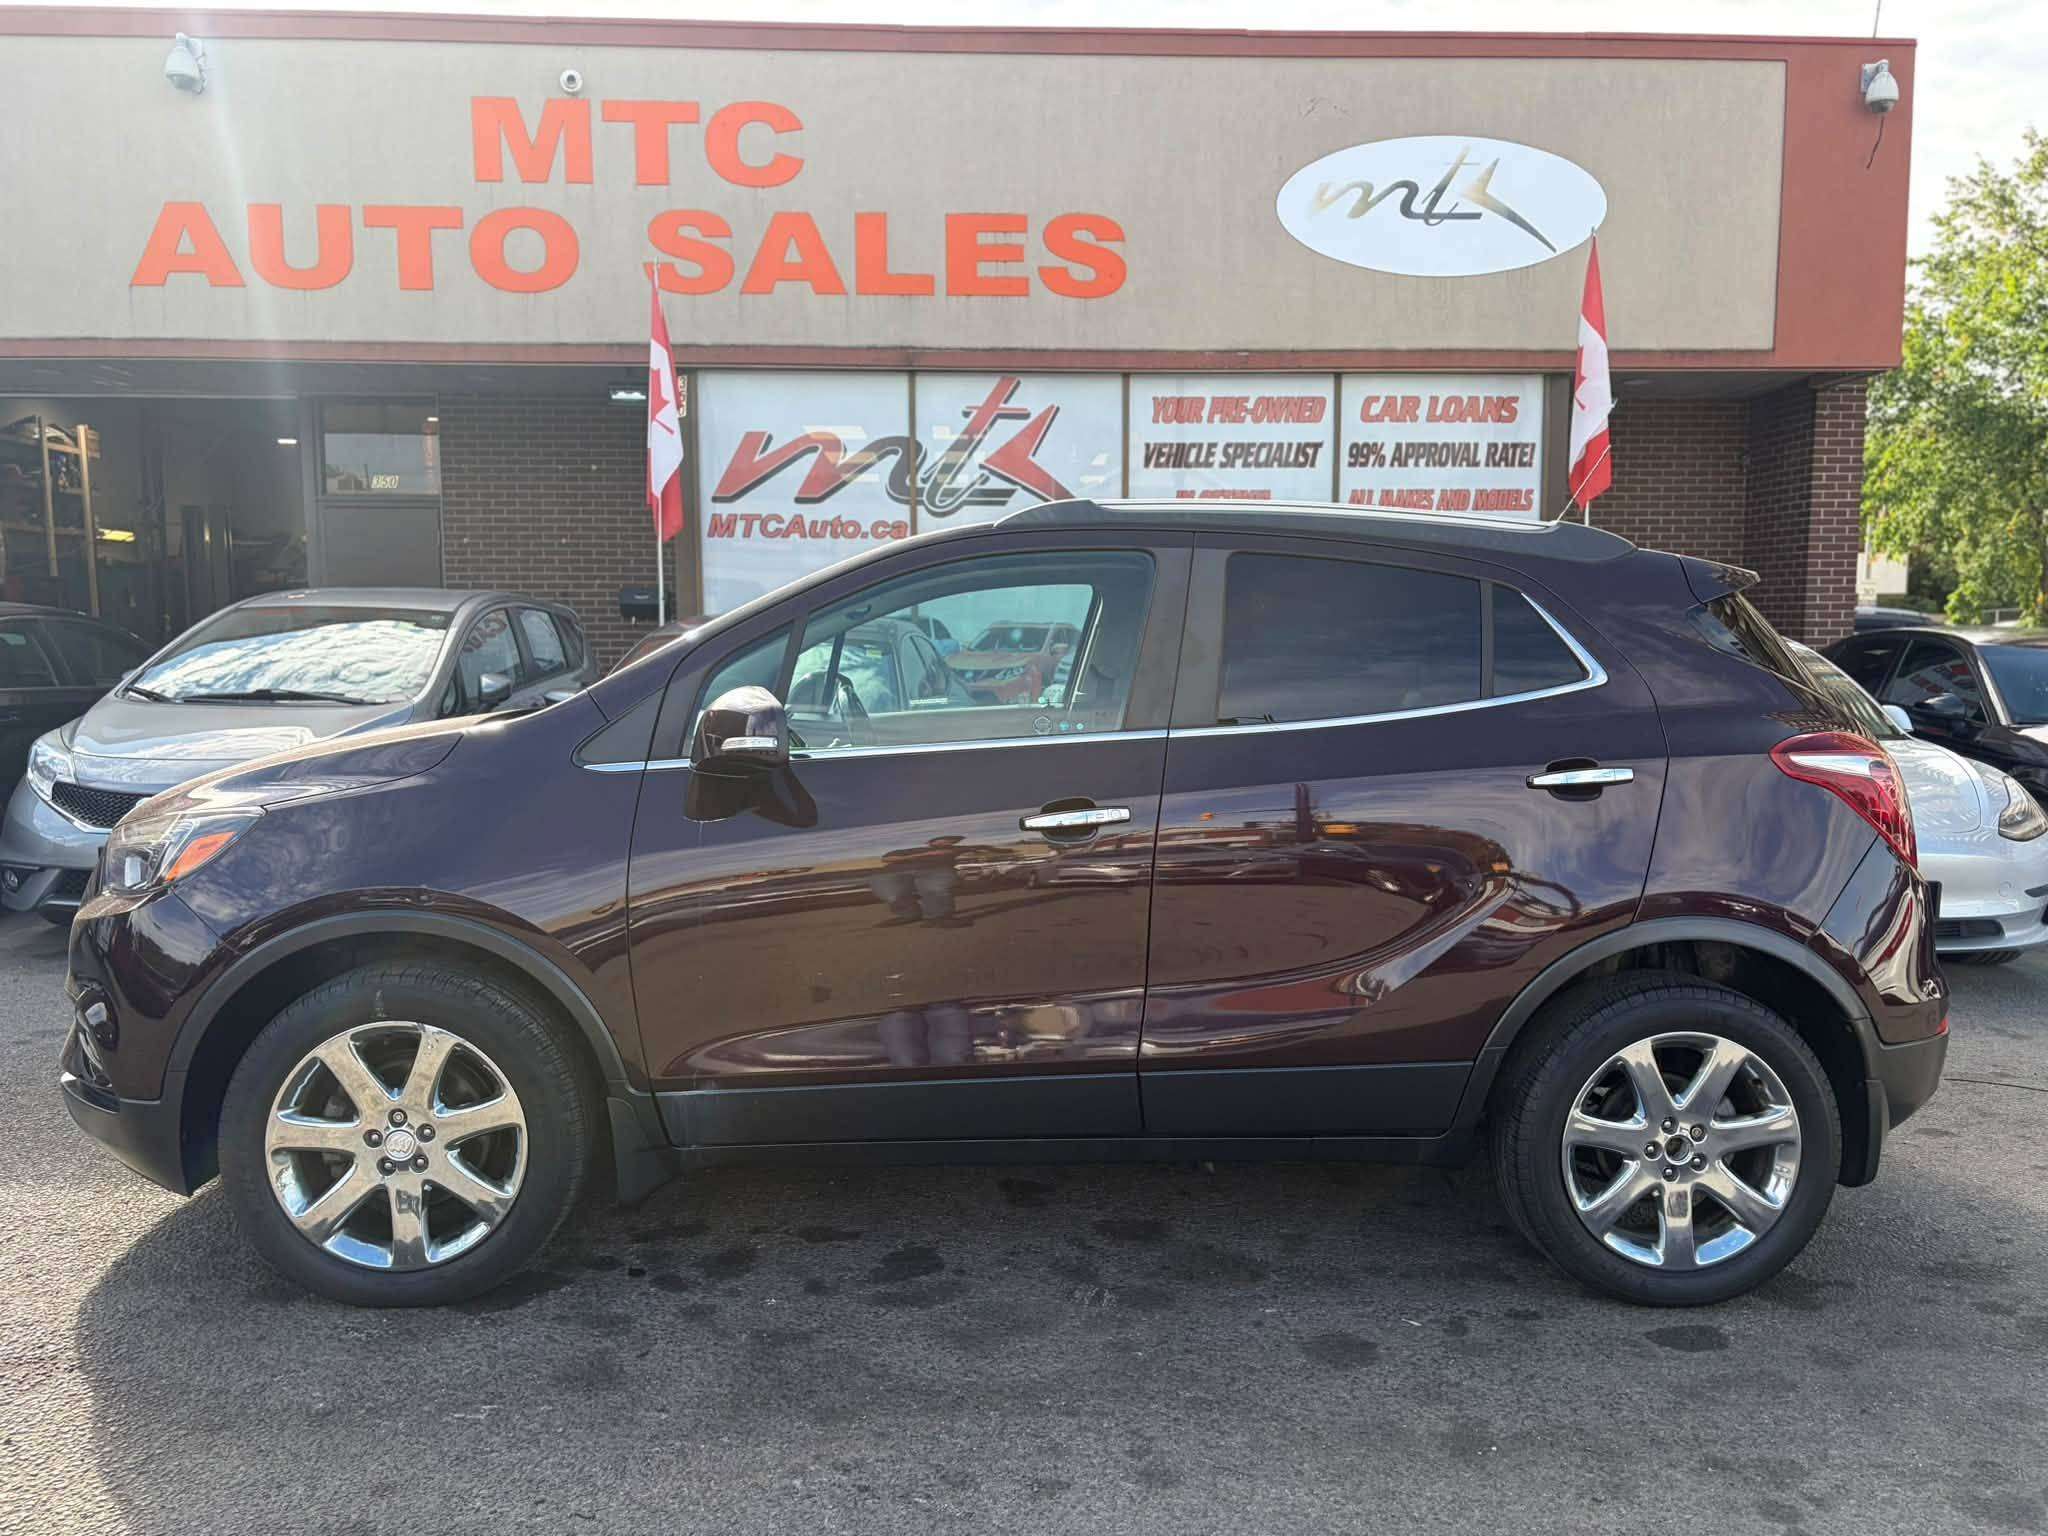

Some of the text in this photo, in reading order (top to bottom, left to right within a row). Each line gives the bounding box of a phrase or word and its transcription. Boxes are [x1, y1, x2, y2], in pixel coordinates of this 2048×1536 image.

[471, 97, 803, 188] MTC
[130, 201, 1128, 299] AUTO SALES
[1152, 396, 1327, 424] YOUR PRE-OWNED
[1360, 395, 1520, 424] CAR LOANS
[1143, 442, 1323, 469] VEHICLE SPECIALIST
[1348, 442, 1536, 468] 99% APPROVAL RATE!
[1379, 489, 1435, 511] MAKES
[1436, 489, 1471, 511] AND
[1472, 489, 1535, 512] MODELS
[707, 513, 909, 540] MTCAuto.ca
